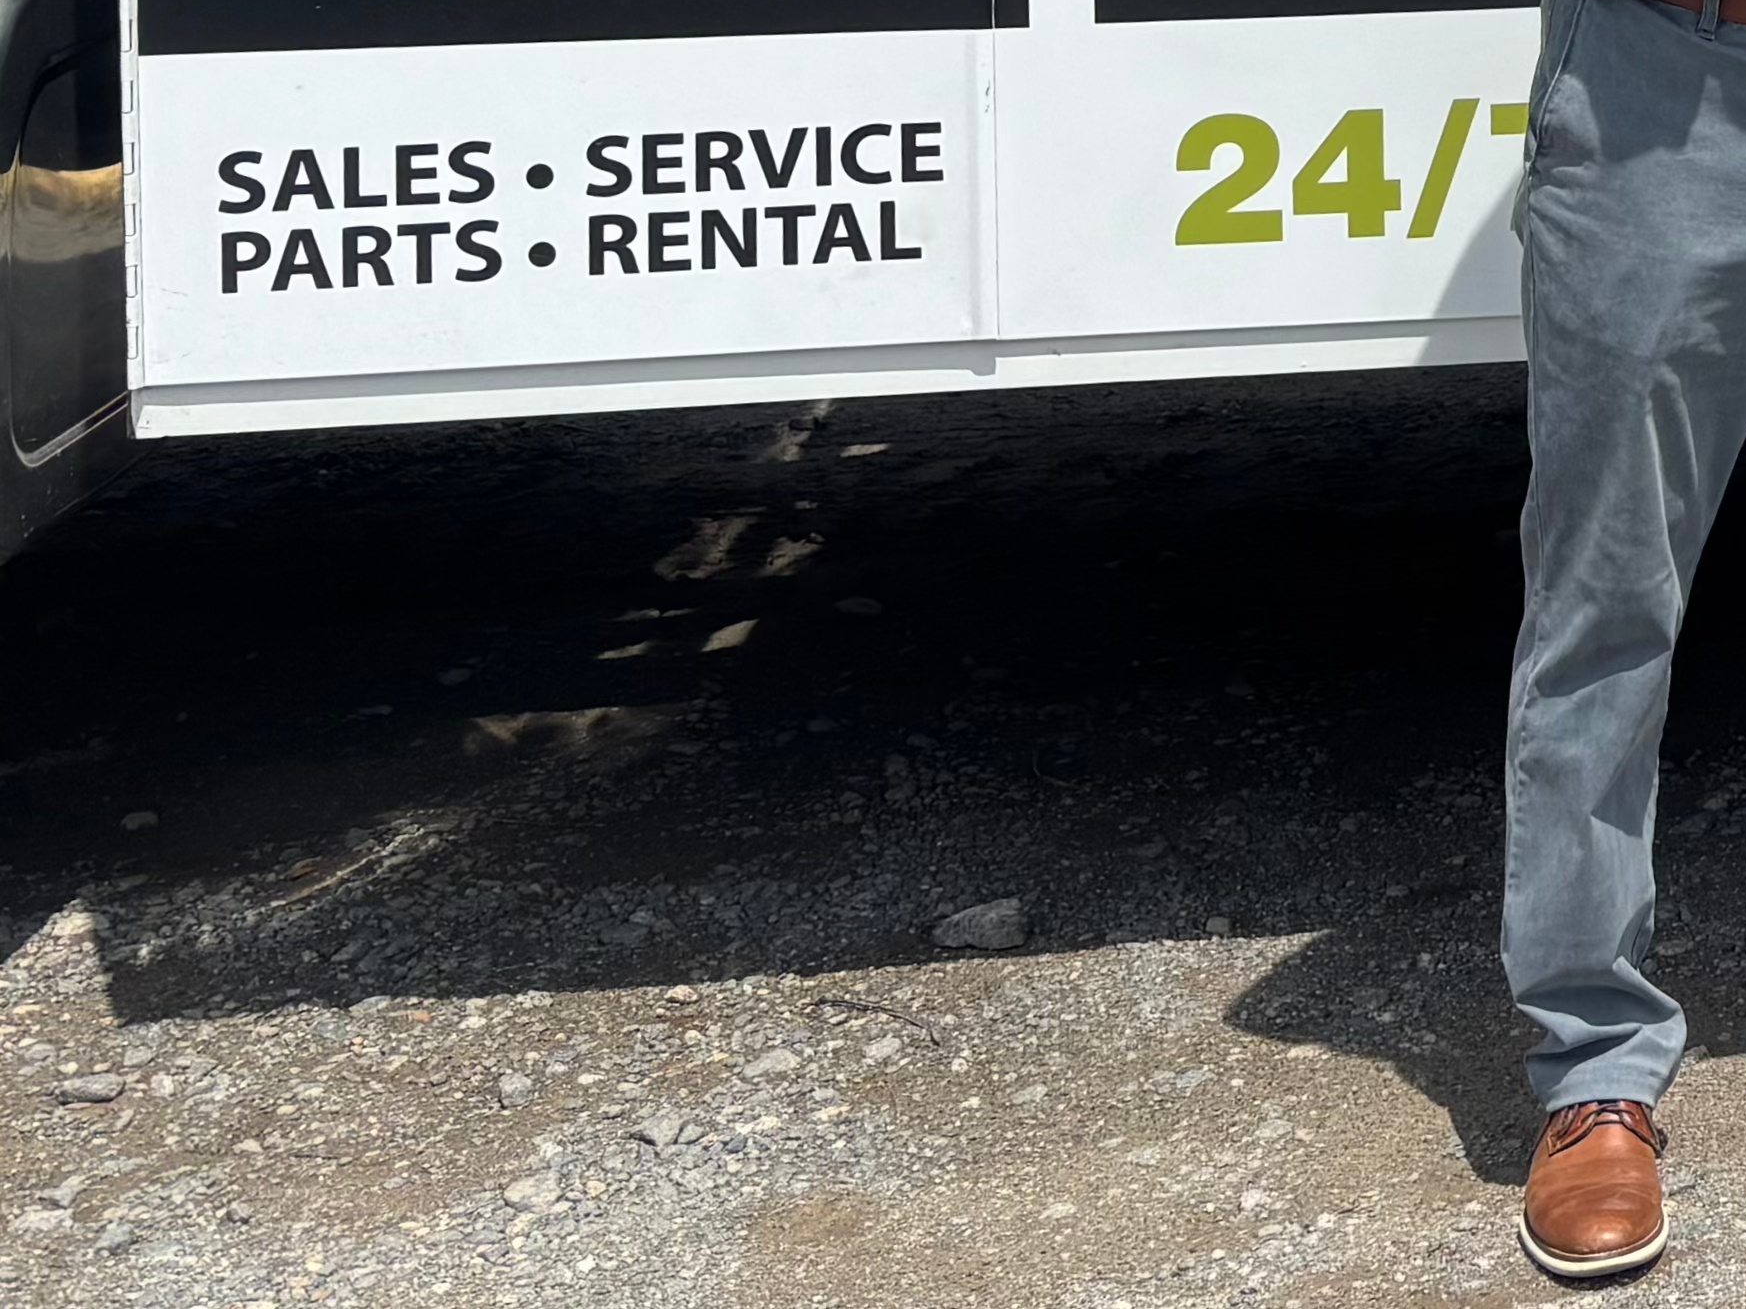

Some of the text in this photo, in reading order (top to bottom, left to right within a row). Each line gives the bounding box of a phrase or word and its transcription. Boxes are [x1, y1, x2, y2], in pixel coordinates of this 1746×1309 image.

[218, 121, 945, 214] SALES SERVICE
[1175, 98, 1528, 246] 24/
[220, 201, 922, 294] PARTS RENTAL
